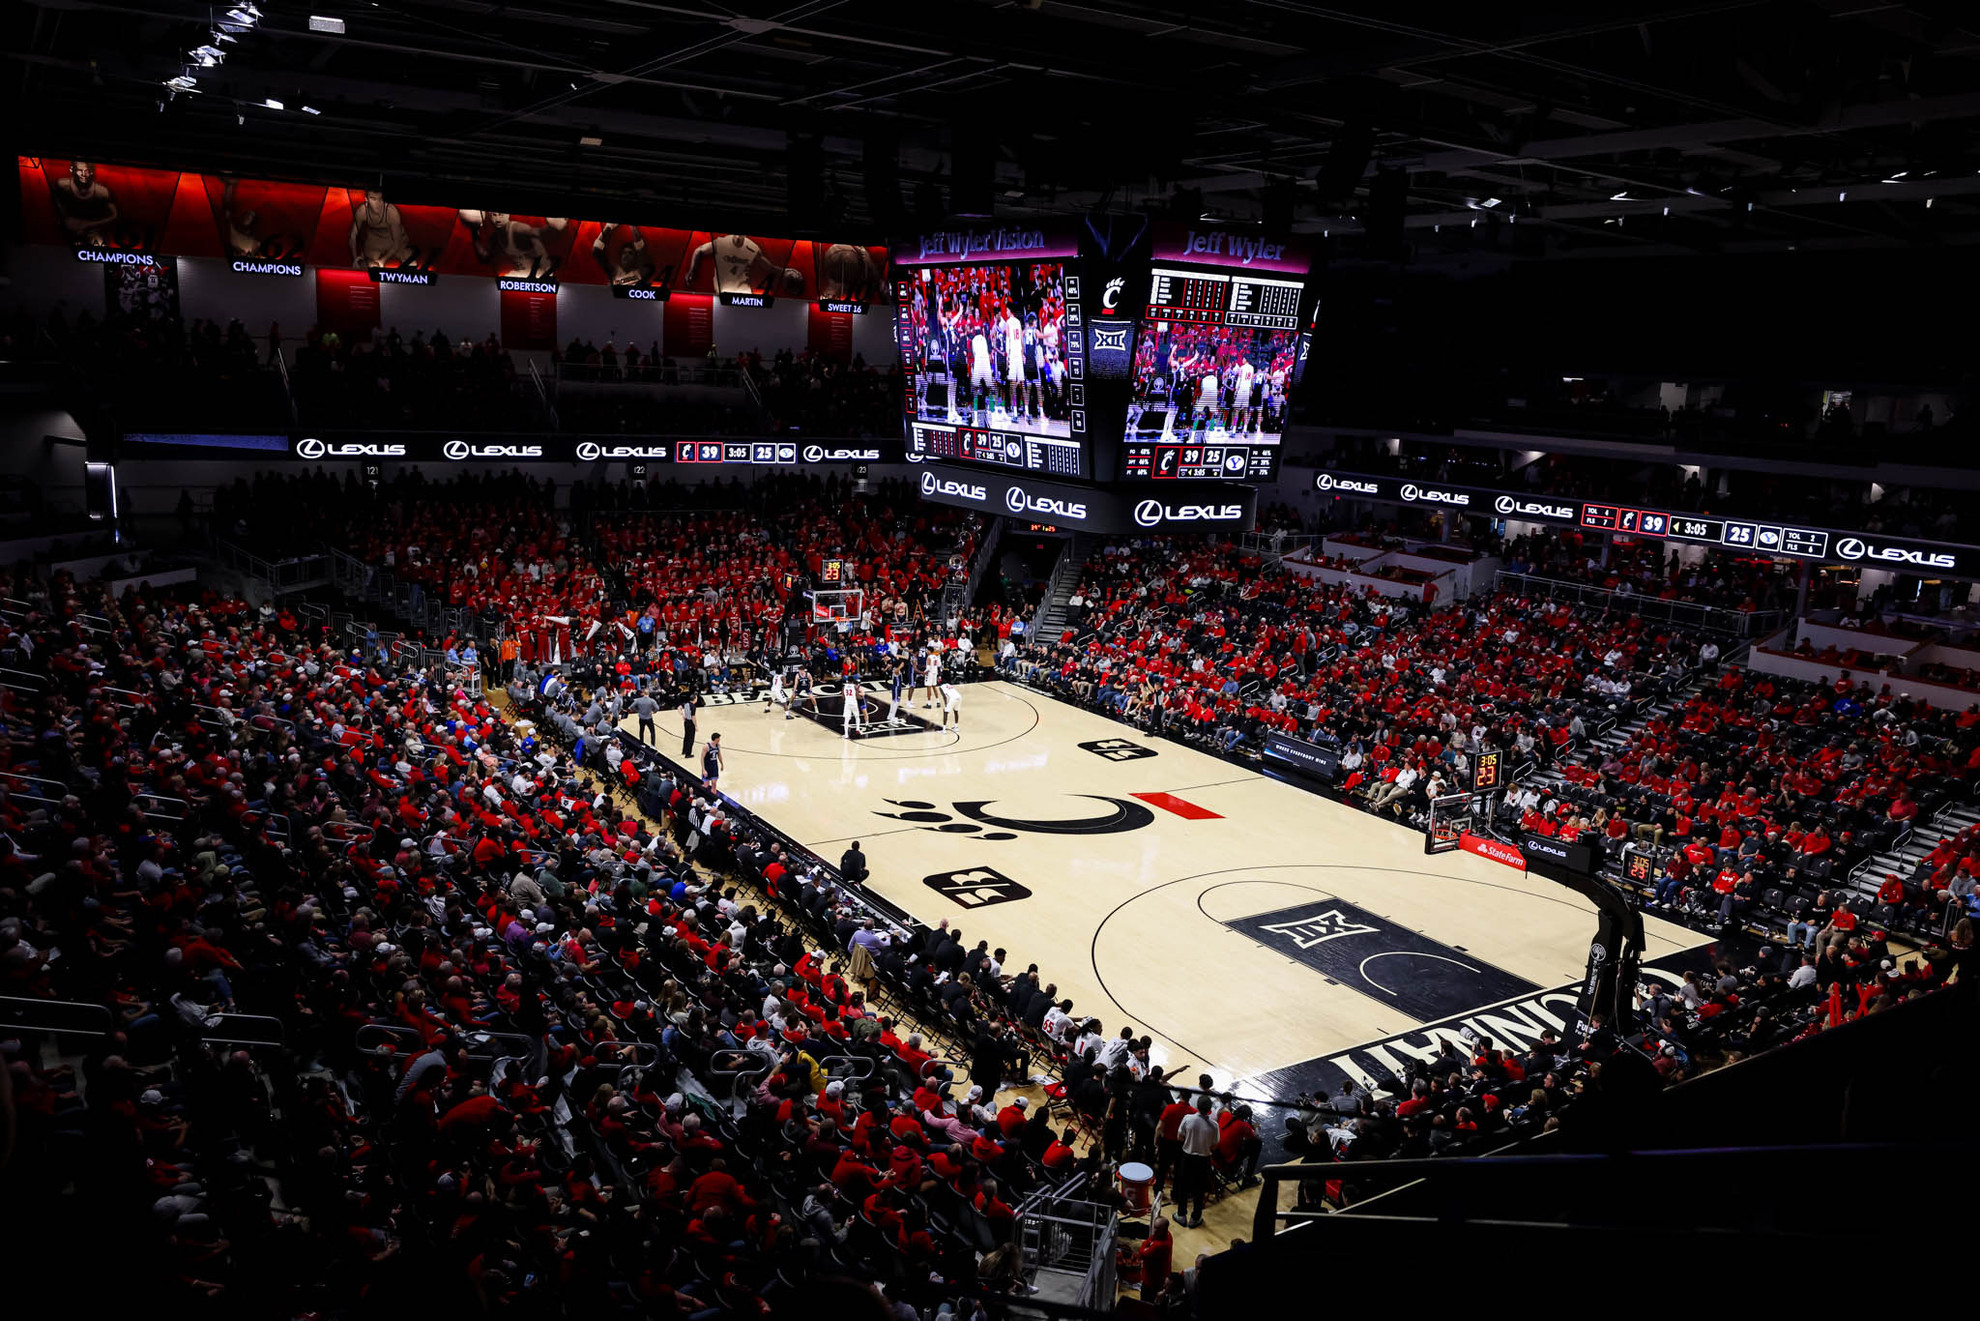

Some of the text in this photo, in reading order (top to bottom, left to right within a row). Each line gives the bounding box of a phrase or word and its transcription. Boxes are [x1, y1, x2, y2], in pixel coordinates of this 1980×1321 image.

[920, 225, 1044, 260] Jeff Wyler Vision
[1183, 231, 1286, 264] Jeff Wyler
[77, 250, 154, 266] CHAMPIONS
[232, 260, 302, 276] CHAMPIONS
[379, 271, 428, 285] TWYMAN
[500, 281, 557, 294] ROBERTSON
[628, 289, 656, 300] COOK
[731, 296, 764, 307] MARTIN
[827, 303, 862, 314] SWEET 16
[977, 434, 987, 446] 39
[992, 436, 1002, 448] 25
[327, 444, 406, 456] LEXUS
[471, 446, 542, 457] LEXUS
[602, 447, 666, 457] LEXUS
[702, 445, 718, 459] 39
[728, 447, 747, 458] 3:05
[757, 447, 772, 459] 25
[825, 449, 879, 459] LEXUS
[1184, 450, 1199, 463] 39
[1206, 450, 1220, 463] 25
[367, 466, 379, 475] 121
[937, 481, 986, 500] LEXUS
[1333, 479, 1378, 494] LEXUS
[1418, 490, 1469, 505] LEXUS
[1025, 497, 1087, 519] LEXUS
[1165, 505, 1241, 520] LEXUS
[1516, 501, 1574, 519] LEXUS
[1587, 507, 1598, 515] TOL
[1644, 516, 1663, 531] 39
[1684, 522, 1707, 536] 3:05
[1729, 526, 1750, 543] 25
[1788, 532, 1801, 540] TOL
[1787, 543, 1798, 551] FLS
[1868, 546, 1956, 569] LEXUS
[825, 569, 839, 580] 23
[845, 689, 854, 697] 32
[1481, 755, 1497, 767] 3:05
[1476, 766, 1495, 786] 23
[1538, 844, 1566, 858] LEXUS
[1633, 855, 1650, 868] 3:05
[1630, 865, 1646, 880] 23
[1043, 1019, 1055, 1034] 65
[1078, 1041, 1085, 1055] 1
